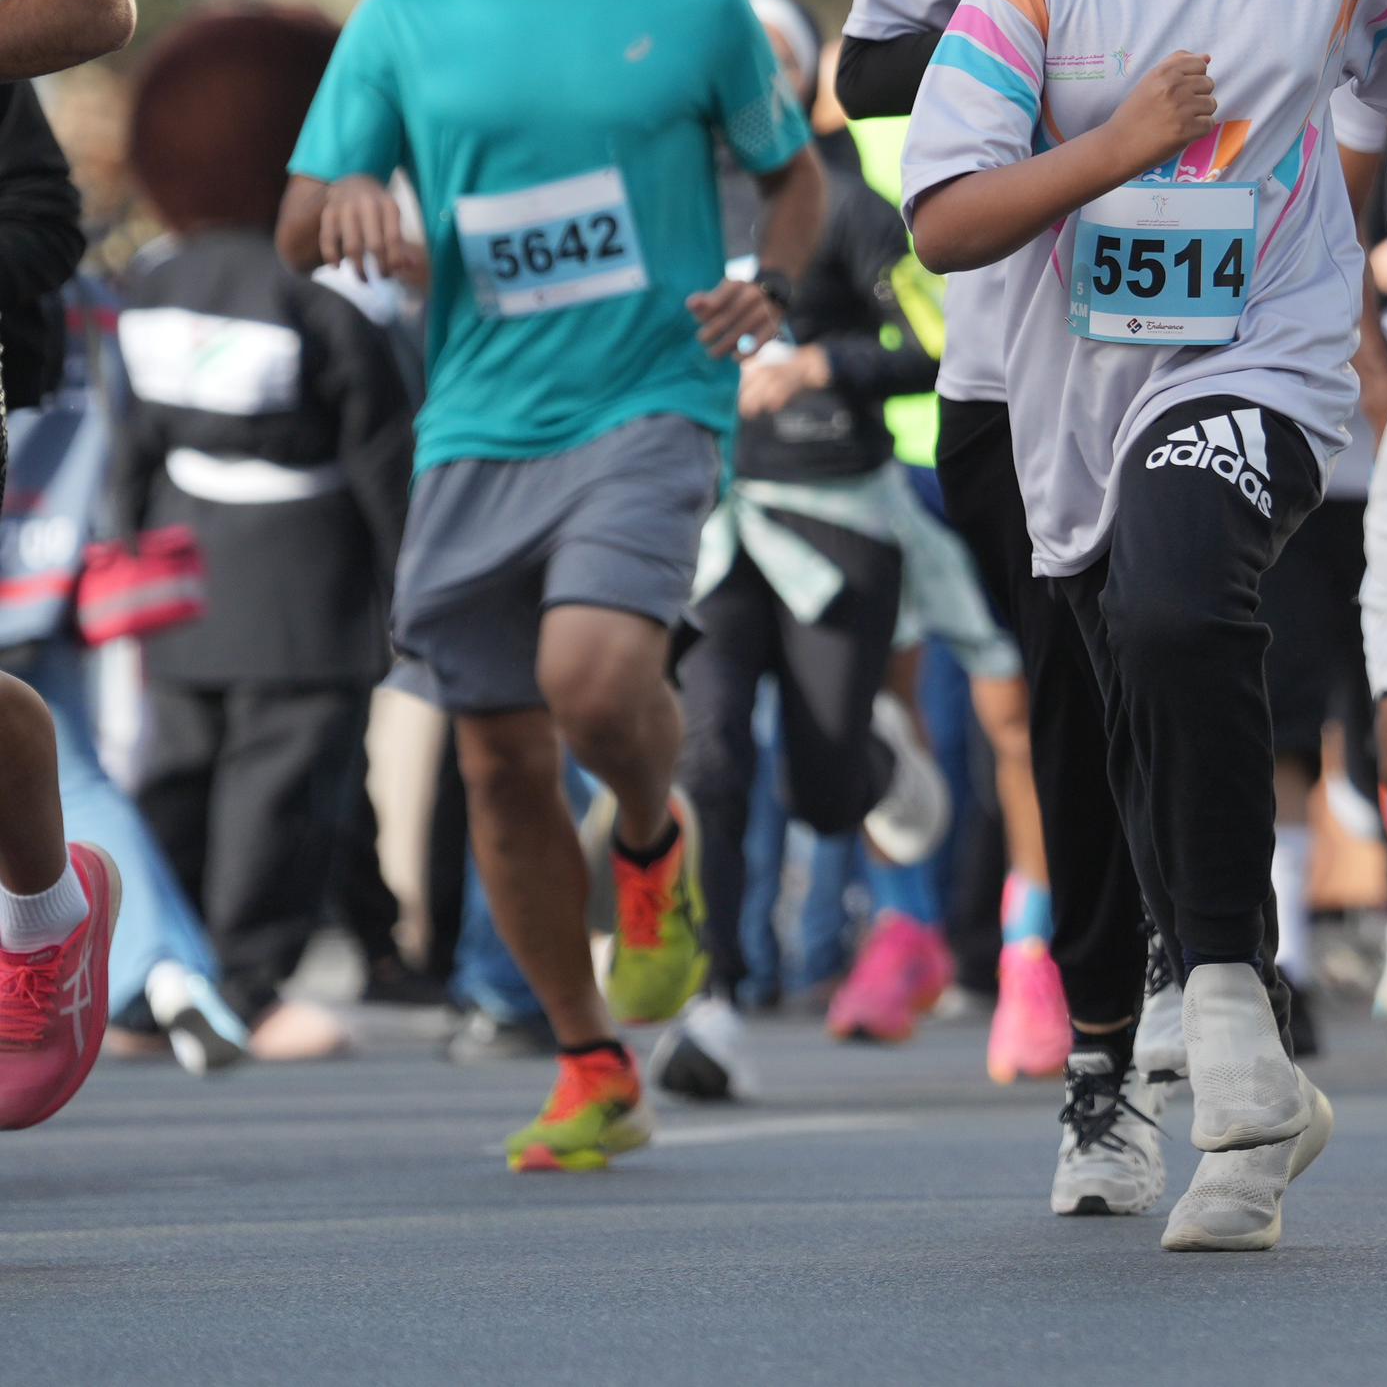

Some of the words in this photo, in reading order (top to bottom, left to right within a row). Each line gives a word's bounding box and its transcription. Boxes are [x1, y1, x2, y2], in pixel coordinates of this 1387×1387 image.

[490, 215, 625, 281] 5642
[1092, 234, 1245, 299] 5514
[1070, 303, 1089, 319] KM
[1076, 283, 1084, 296] 5
[1145, 441, 1272, 519] adidas
